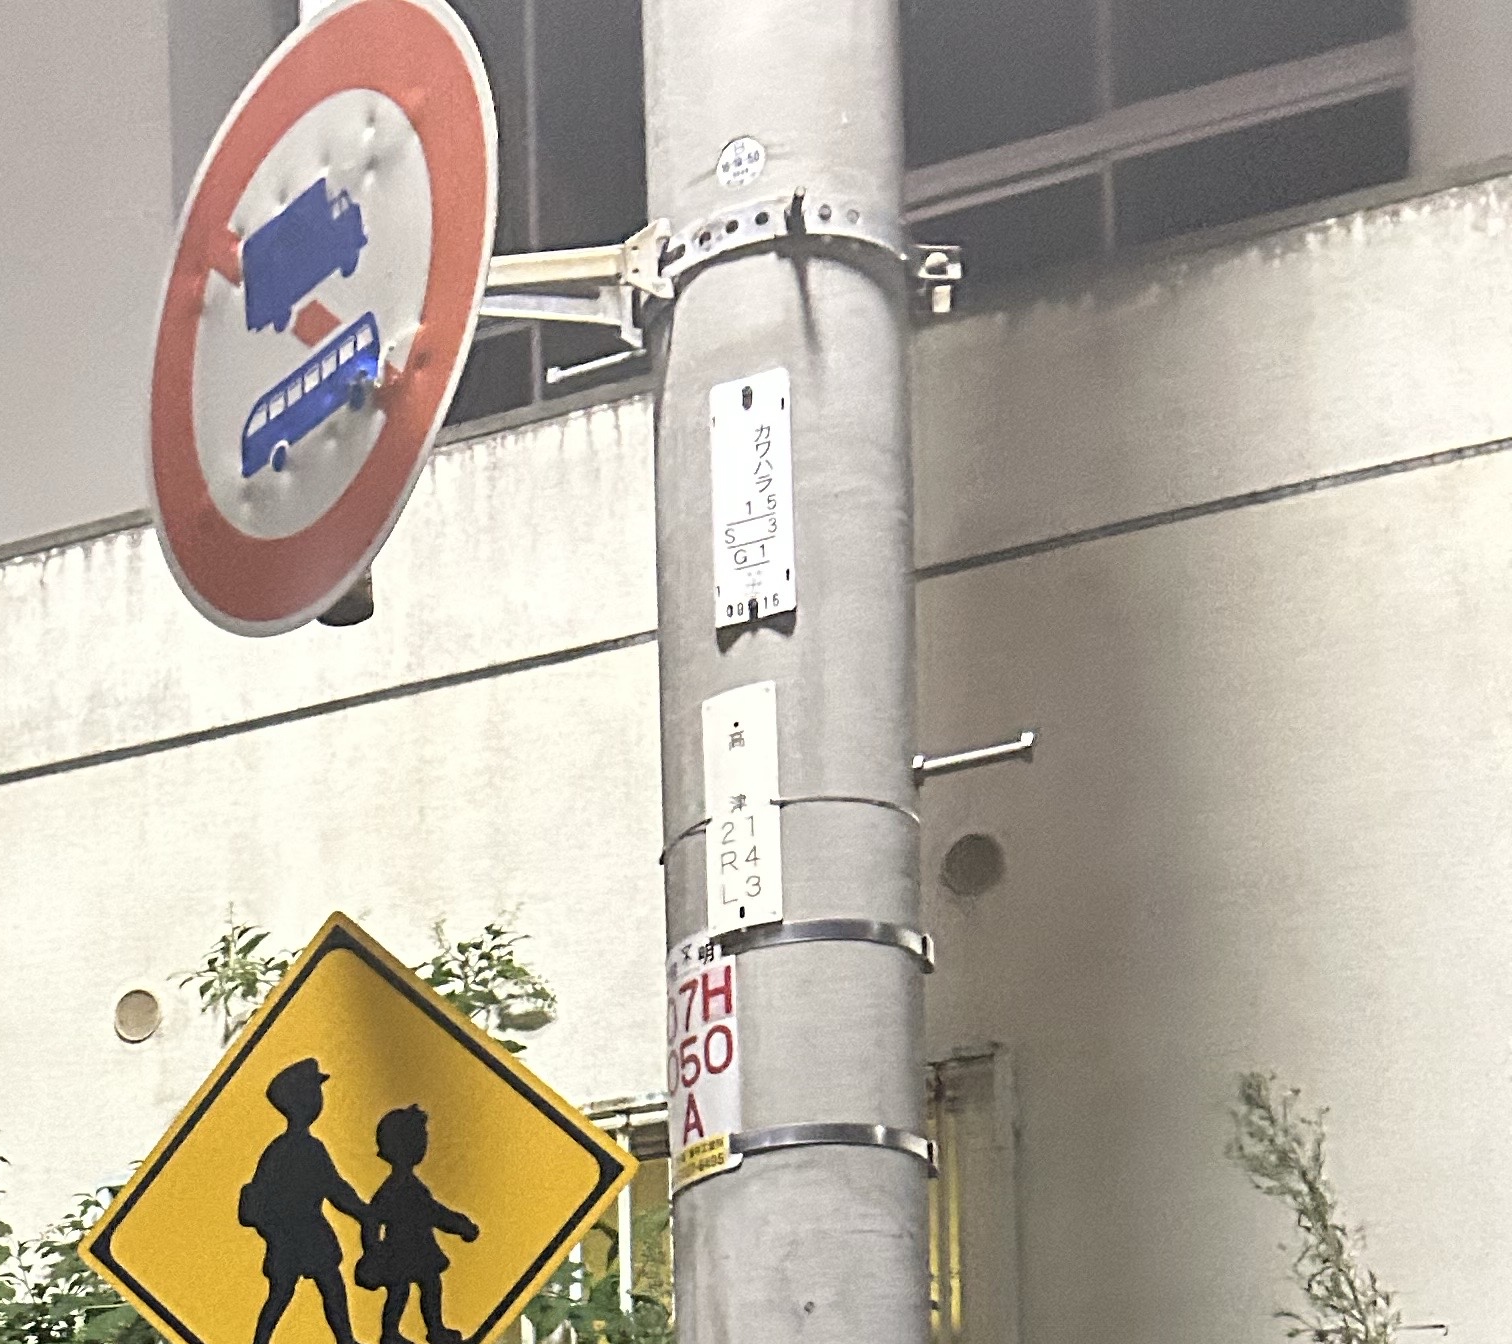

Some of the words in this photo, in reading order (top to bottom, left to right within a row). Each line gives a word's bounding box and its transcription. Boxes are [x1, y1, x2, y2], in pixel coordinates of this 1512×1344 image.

[754, 424, 774, 493] カワハラ
[683, 1092, 704, 1146] A
